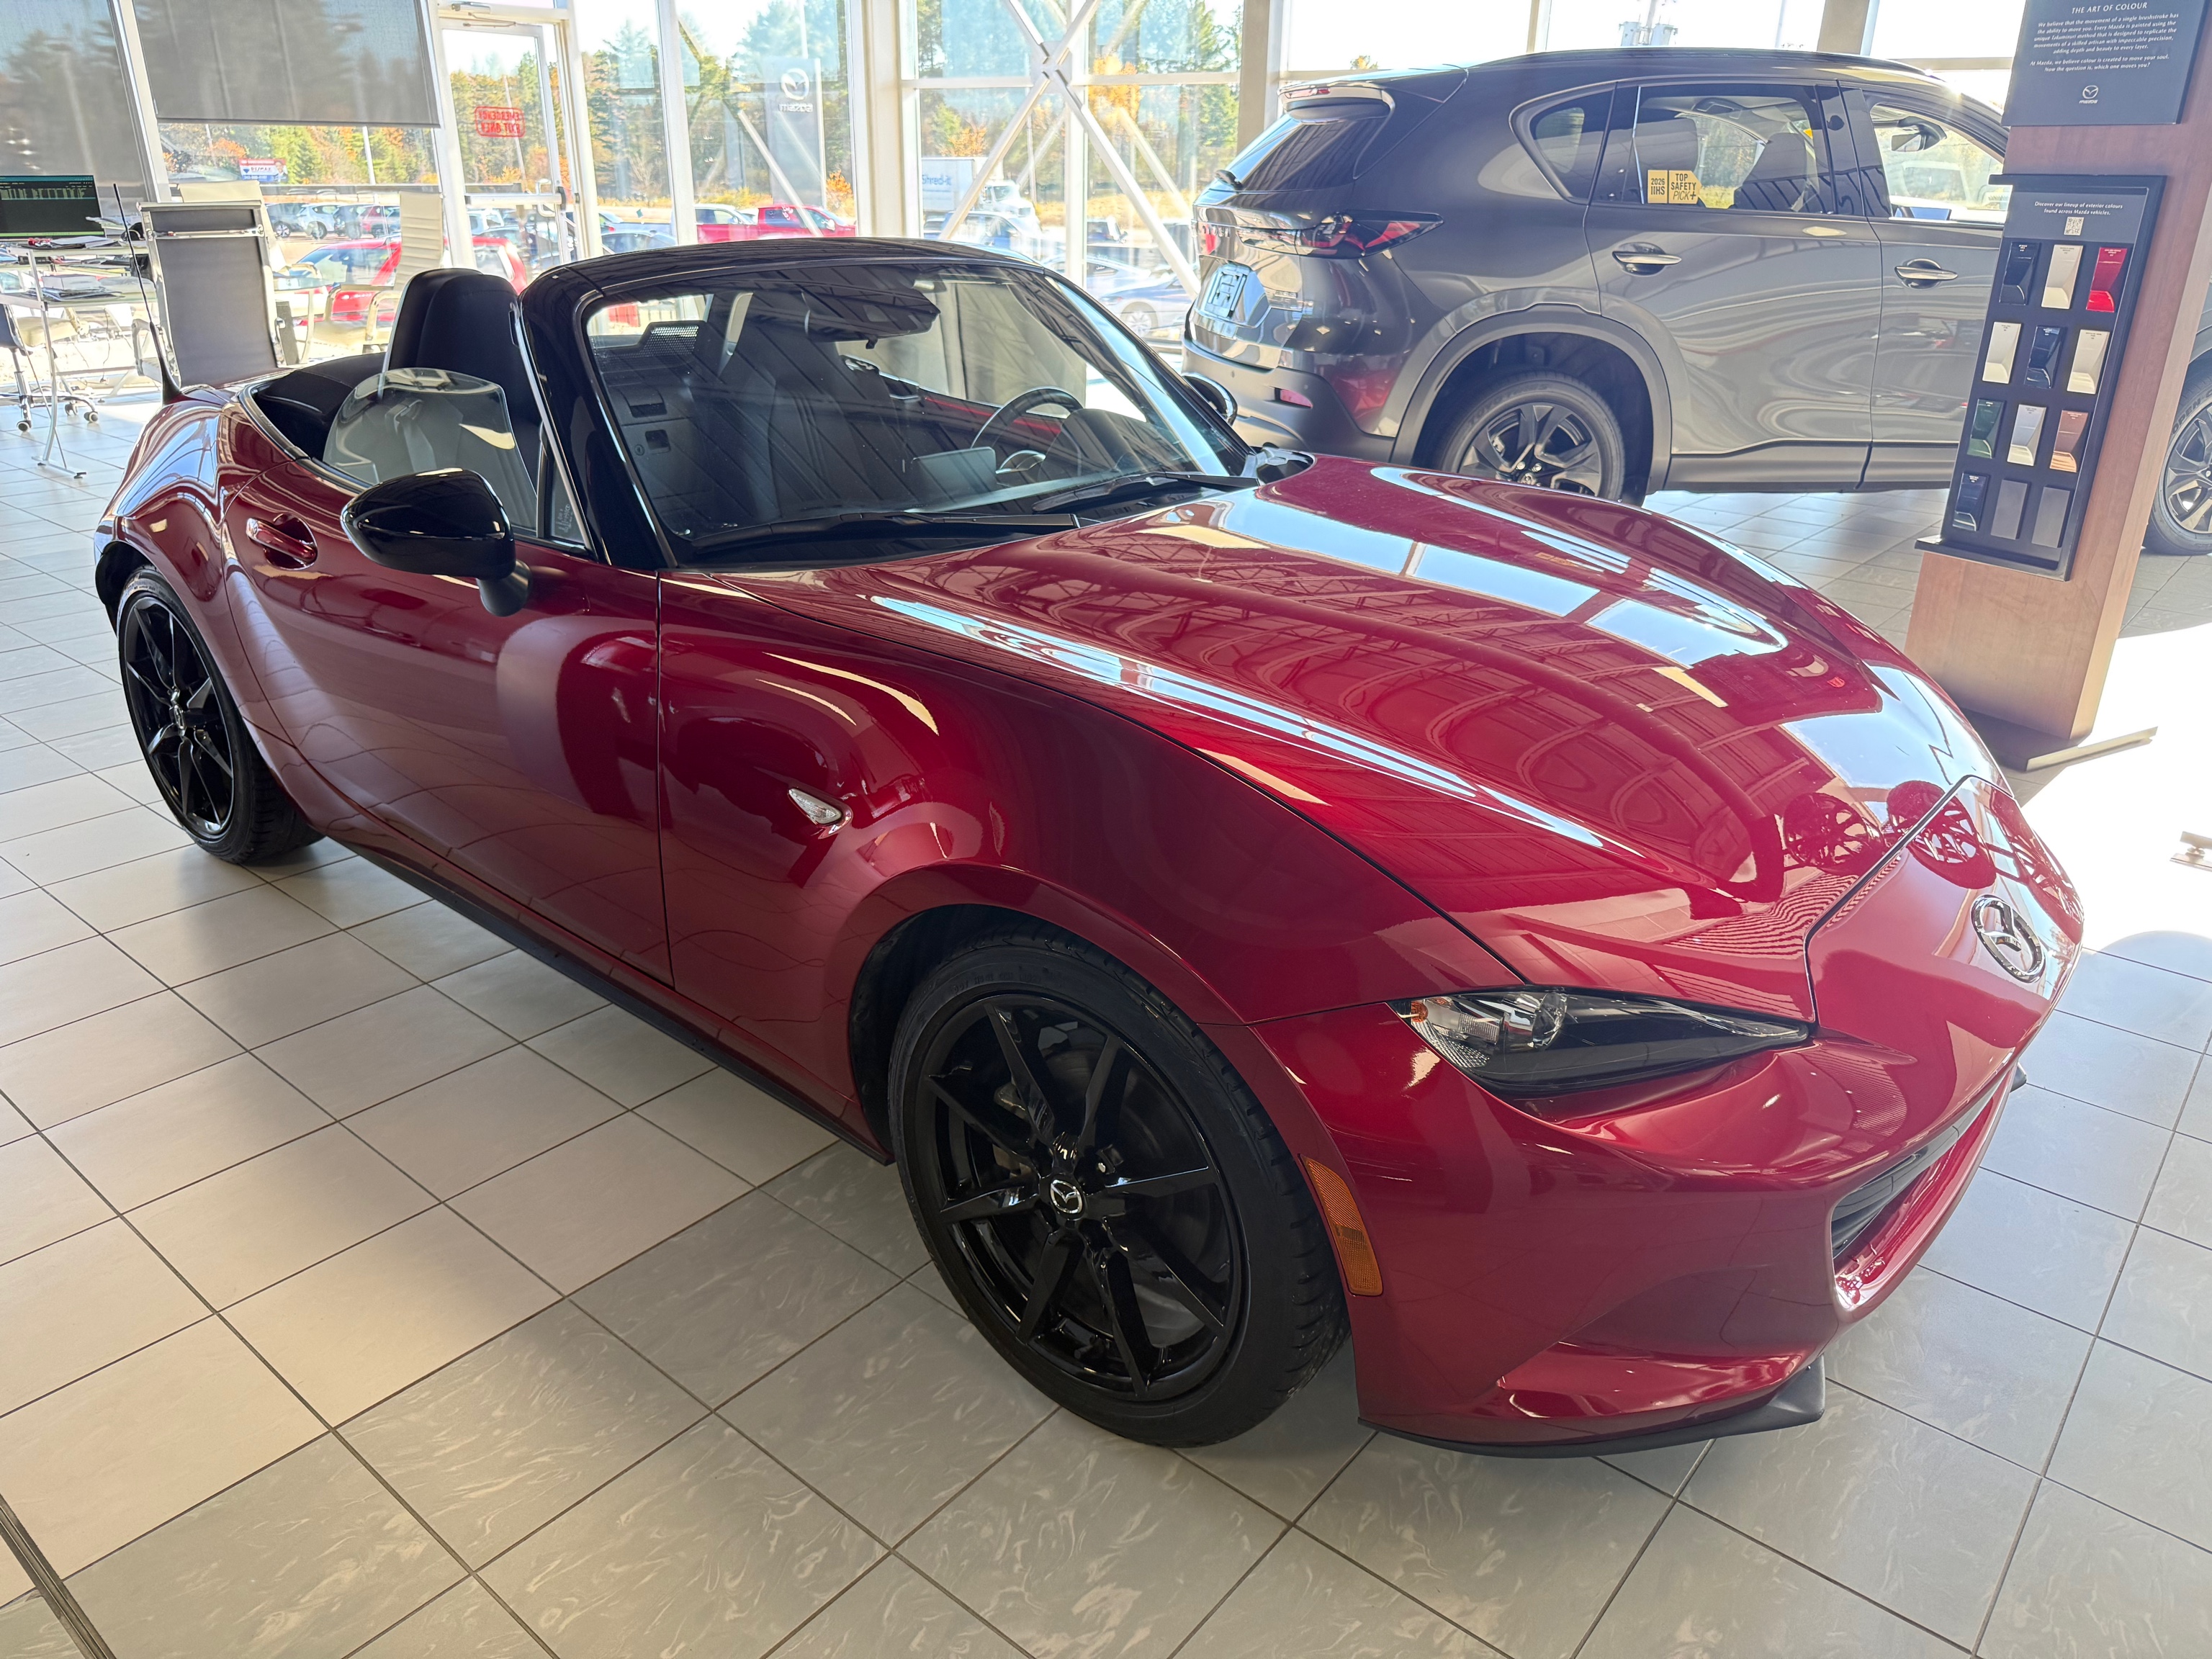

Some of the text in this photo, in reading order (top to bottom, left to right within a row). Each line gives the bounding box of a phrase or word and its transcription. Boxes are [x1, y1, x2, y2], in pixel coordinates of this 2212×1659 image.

[2116, 2, 2147, 11] COLOUR
[1650, 186, 1665, 195] IIHS
[1673, 191, 1696, 200] PICK+
[2172, 397, 2200, 434] OPEN
